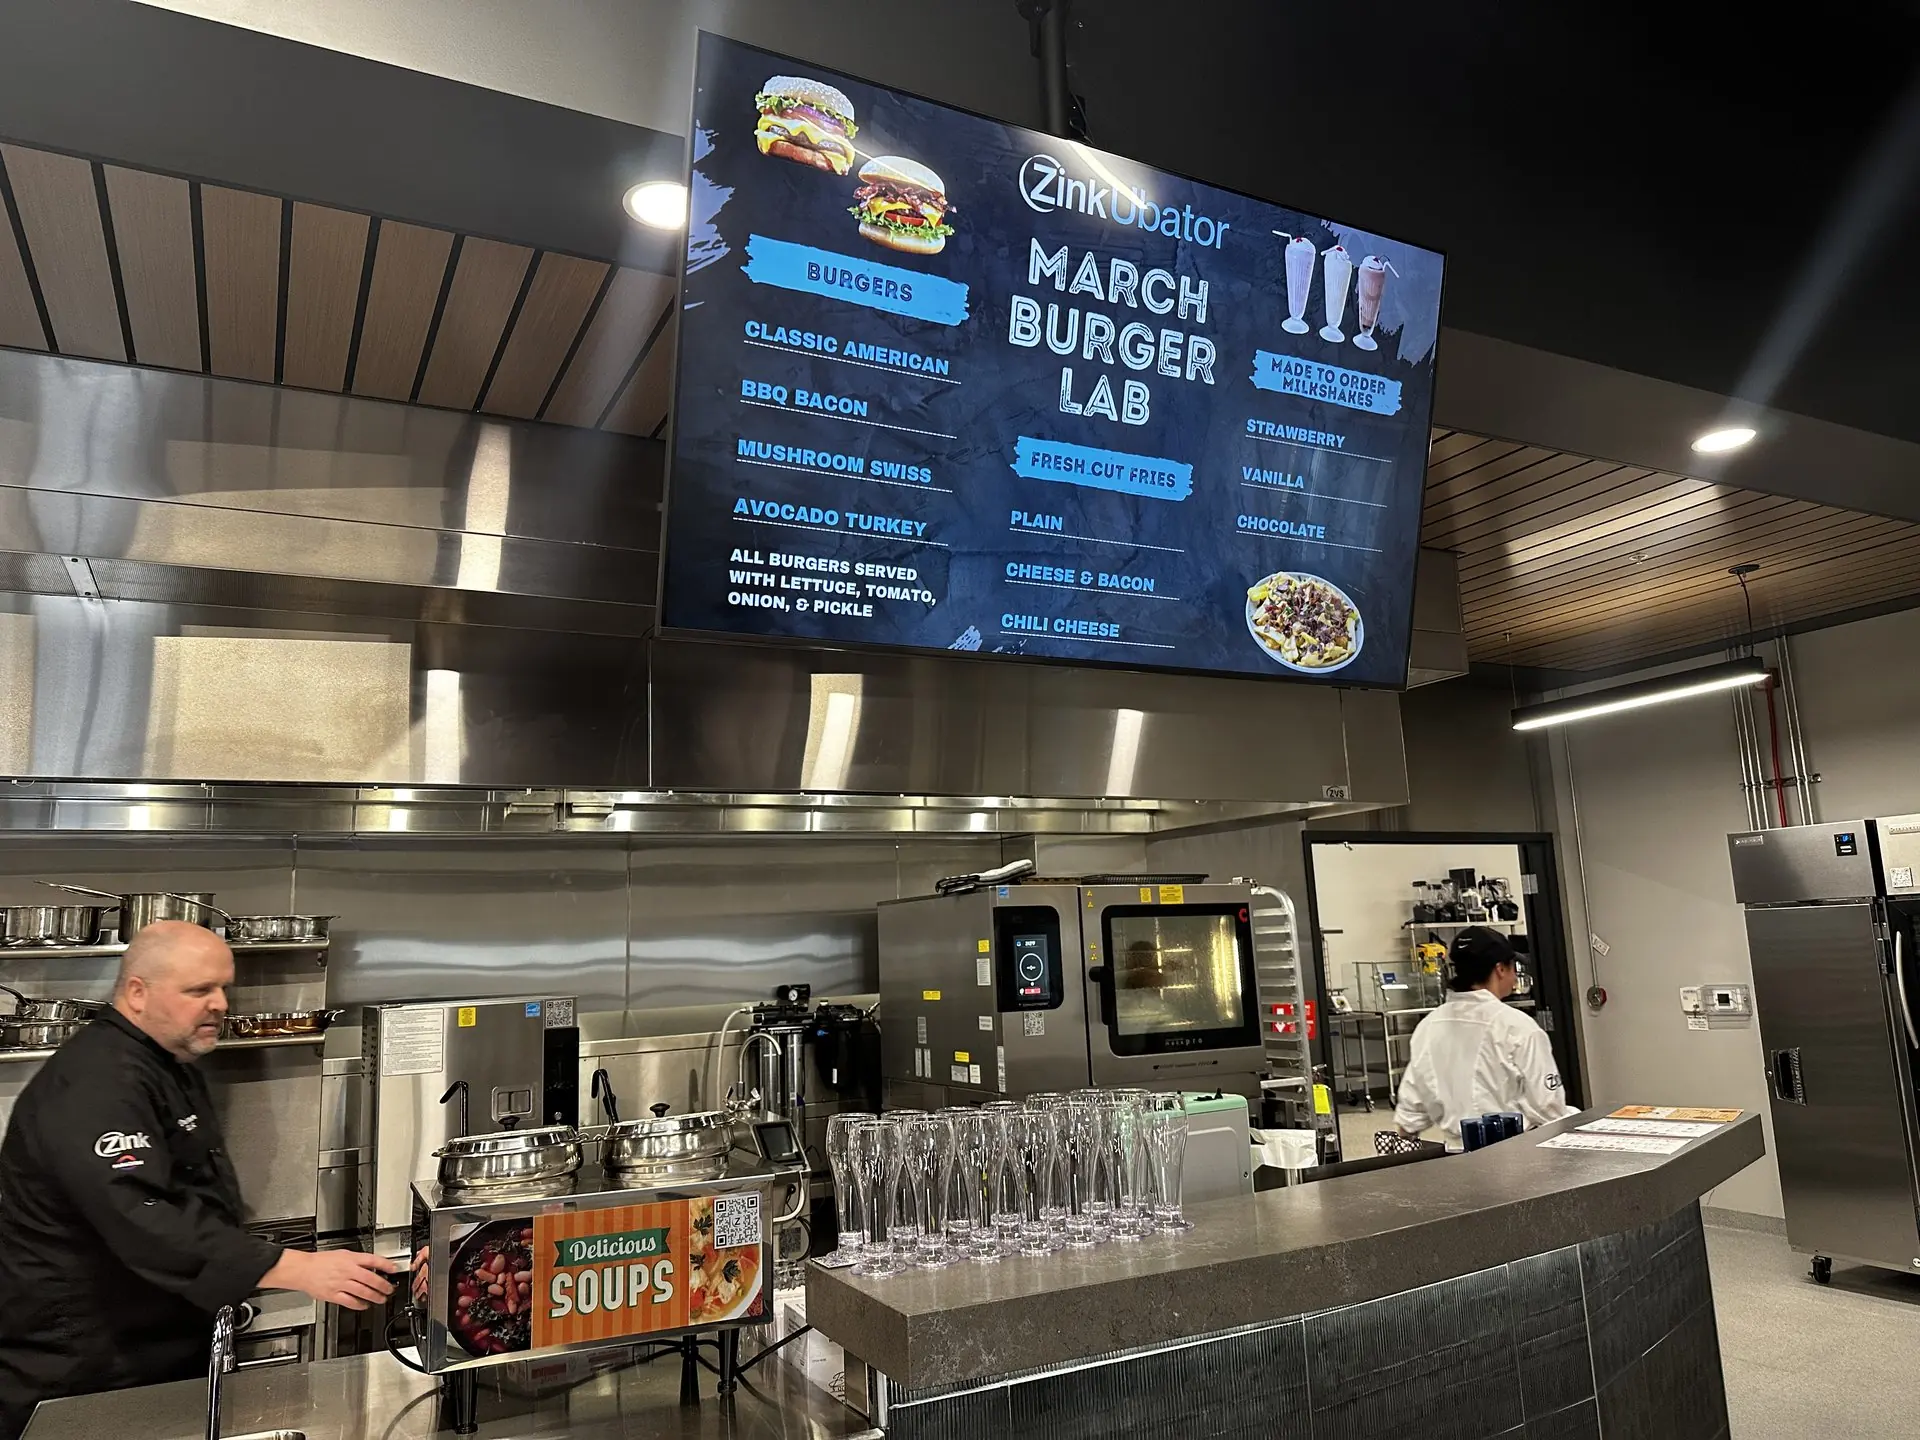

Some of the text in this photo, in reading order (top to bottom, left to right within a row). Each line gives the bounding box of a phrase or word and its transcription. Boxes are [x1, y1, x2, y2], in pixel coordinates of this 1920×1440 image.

[807, 261, 913, 302] BURGERS
[1027, 237, 1209, 324] MARCH
[744, 320, 949, 375] CLASSIC AMERICAN
[1008, 294, 1217, 385] BURGER
[1271, 357, 1386, 395] MADE TO ORDER
[1282, 376, 1373, 408] MILKSHAKES
[741, 379, 868, 417] BBQ BACON
[1059, 367, 1151, 426] LAB
[1246, 418, 1346, 448] STRAWBERRY
[737, 438, 932, 483] MUSHROOM SWISS
[1031, 451, 1176, 488] FRESH CUT FRIES
[1242, 466, 1304, 489] VANILLA
[733, 498, 927, 537] AVOCADO TURKEY
[1010, 510, 1064, 531] PLAIN
[1237, 514, 1326, 539] CHOCOLATE
[730, 548, 918, 581] ALL BURGERS SERVED
[1006, 562, 1155, 592] CHEESE & BACON
[728, 591, 873, 618] ONION, & PICKLE
[729, 569, 937, 606] WITH LETTUCE, TOMATO,
[1001, 613, 1120, 638] CHILI CHEESE
[95, 1132, 152, 1157] Zink
[569, 1235, 657, 1262] Delicious
[549, 1259, 675, 1318] SOUPS
